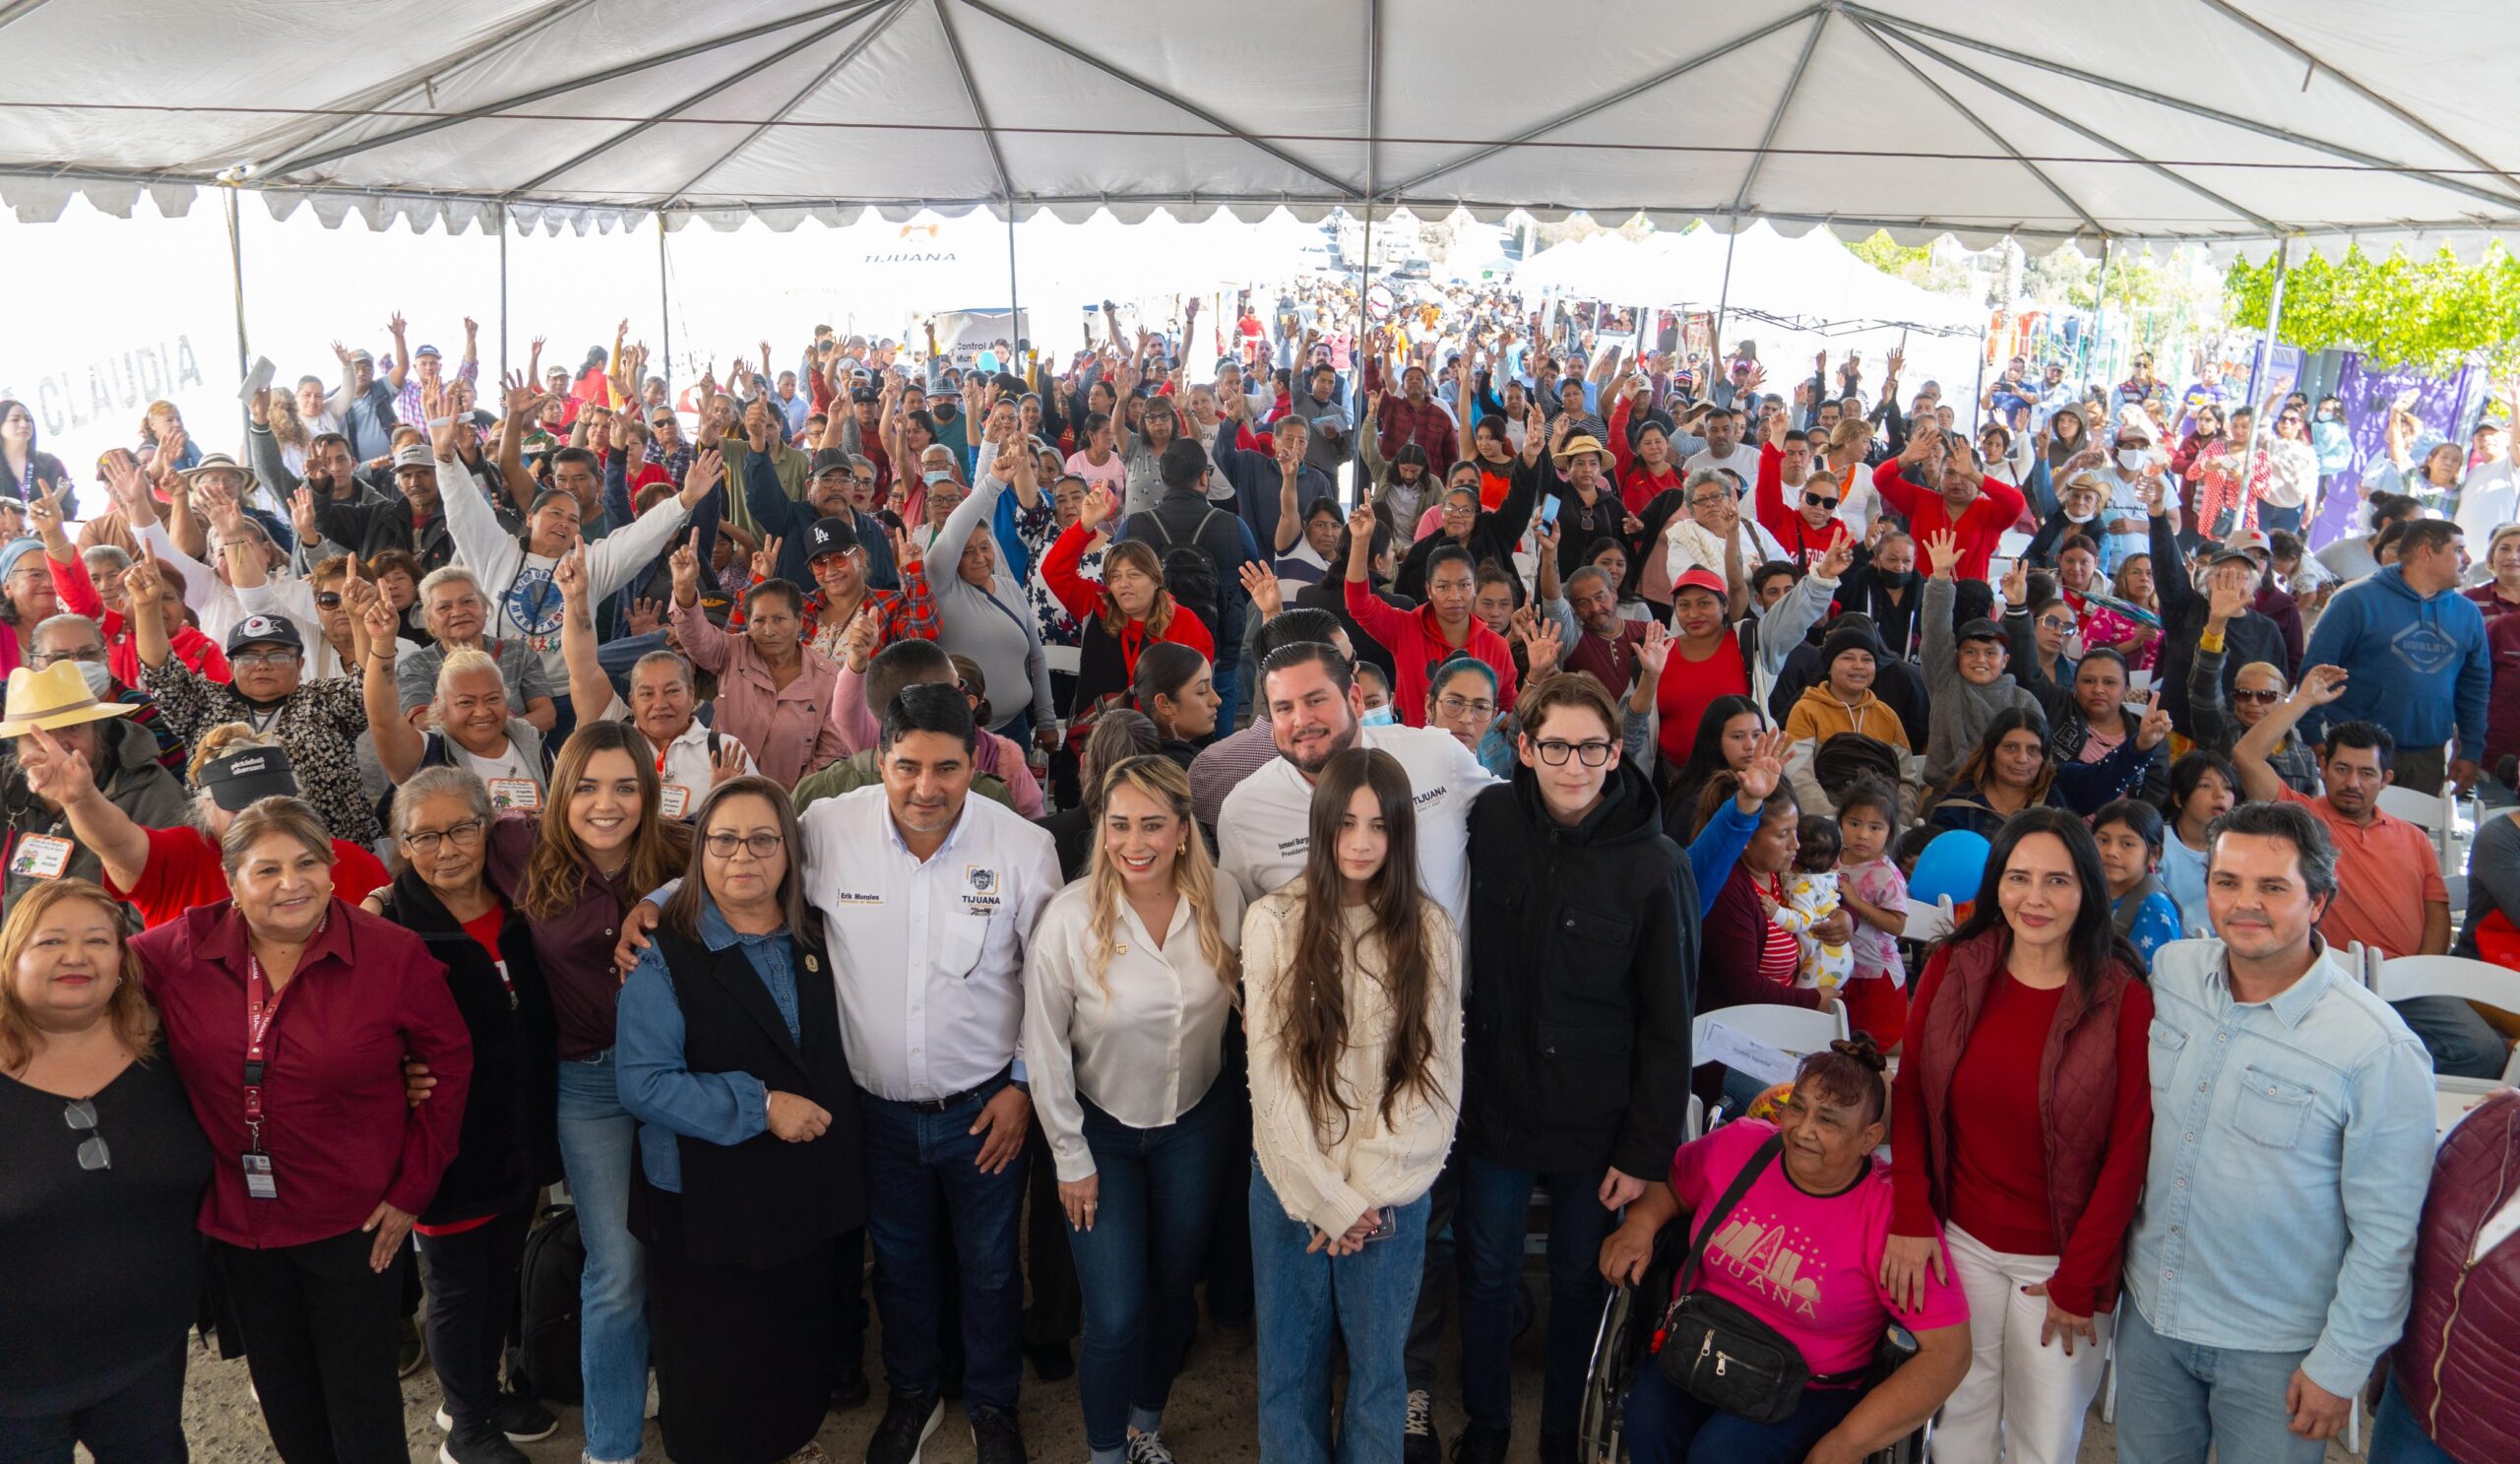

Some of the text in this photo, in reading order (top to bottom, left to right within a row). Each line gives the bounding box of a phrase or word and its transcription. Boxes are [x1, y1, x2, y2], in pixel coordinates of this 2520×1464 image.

[865, 253, 957, 263] TIJUANA
[957, 342, 986, 351] Control
[38, 334, 204, 437] CLAUDIA
[814, 527, 830, 544] LA
[1414, 786, 1448, 805] TIJUANA
[962, 895, 1001, 905] TIJUANA
[255, 1016, 271, 1043] TIJUANA
